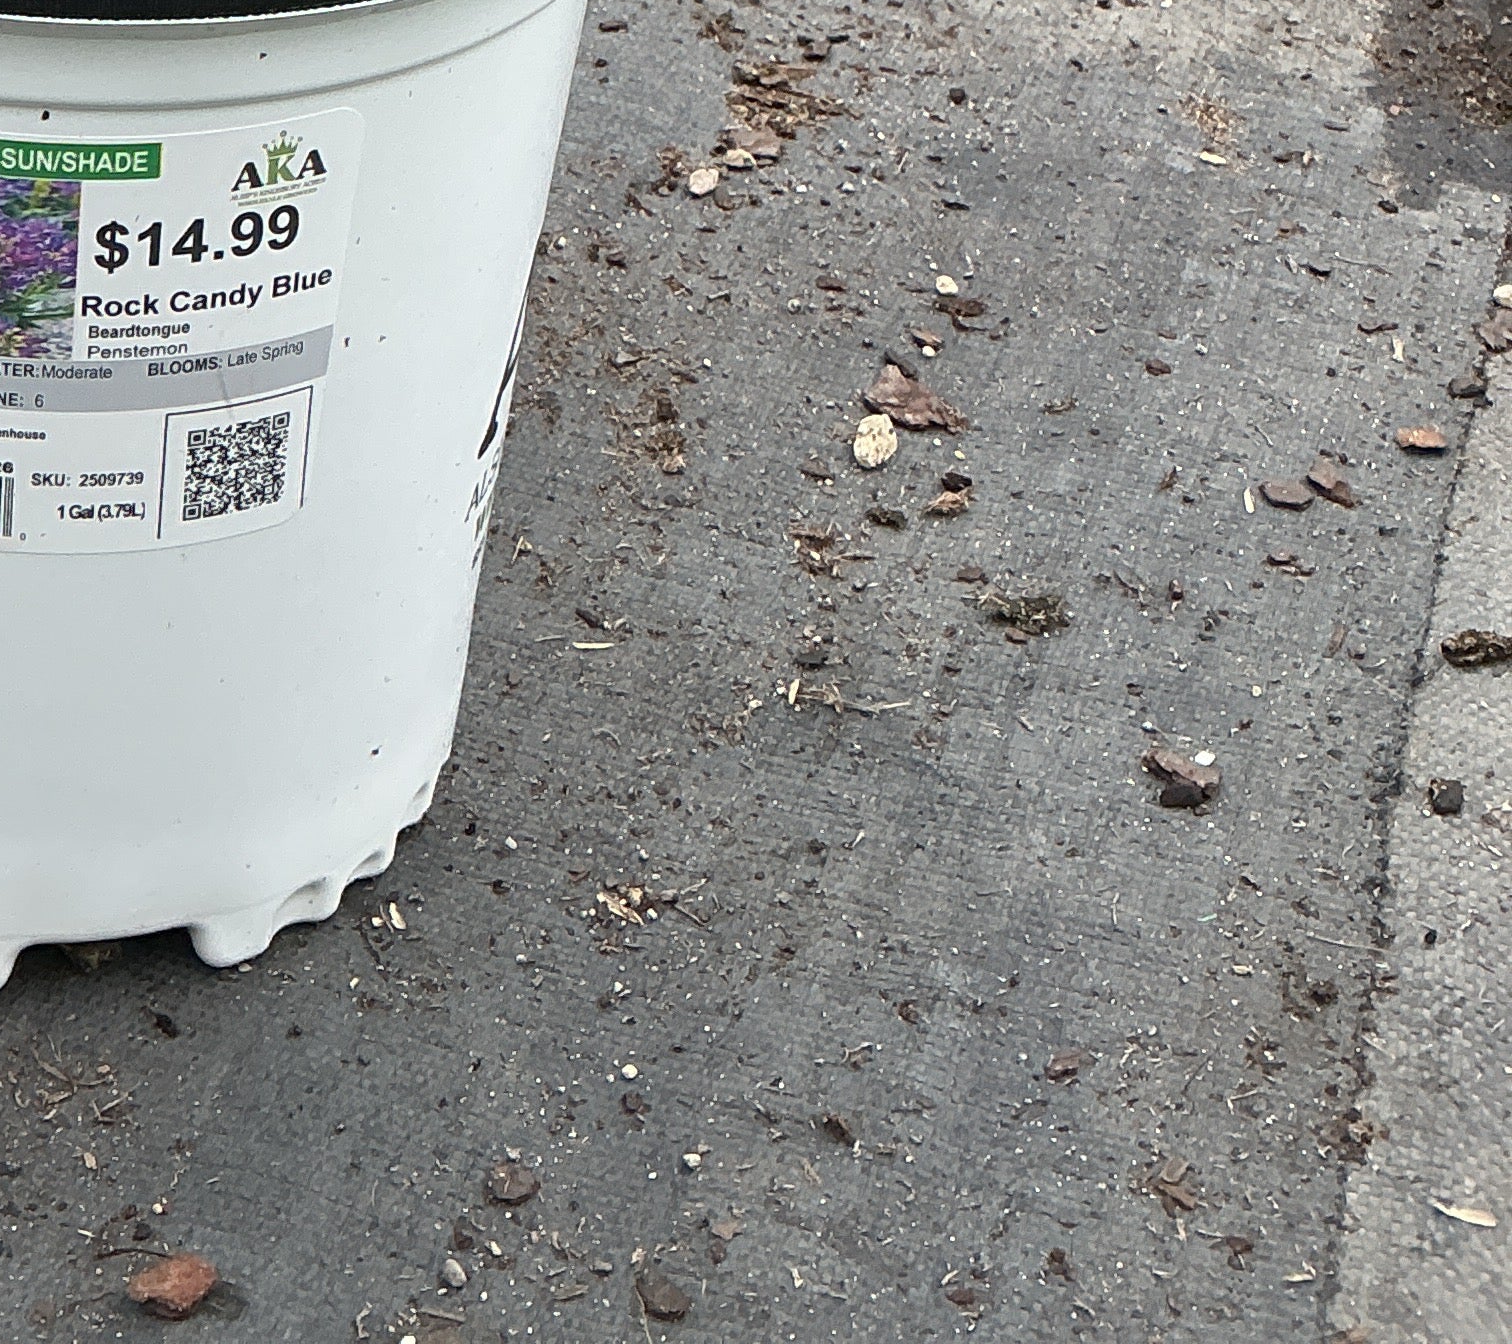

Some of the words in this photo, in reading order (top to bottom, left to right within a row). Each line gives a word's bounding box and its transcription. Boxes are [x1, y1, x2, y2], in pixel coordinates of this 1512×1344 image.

[0, 148, 149, 174] SUN/SHADE
[231, 149, 327, 192] AKA
[94, 204, 300, 274] $14.99
[81, 294, 159, 317] Rock
[170, 283, 263, 312] Candy
[272, 268, 332, 298] Blue
[88, 321, 191, 339] Beardtongue
[87, 341, 188, 359] Penstemon
[148, 357, 223, 377] BLOOMS:
[227, 352, 257, 368] Late
[261, 340, 304, 362] Spring
[34, 394, 45, 408] 6
[30, 473, 71, 487] SKU:
[78, 471, 145, 487] 2509739
[57, 506, 65, 520] 1
[68, 504, 94, 520] Gal
[97, 502, 147, 523] (3.79L)
